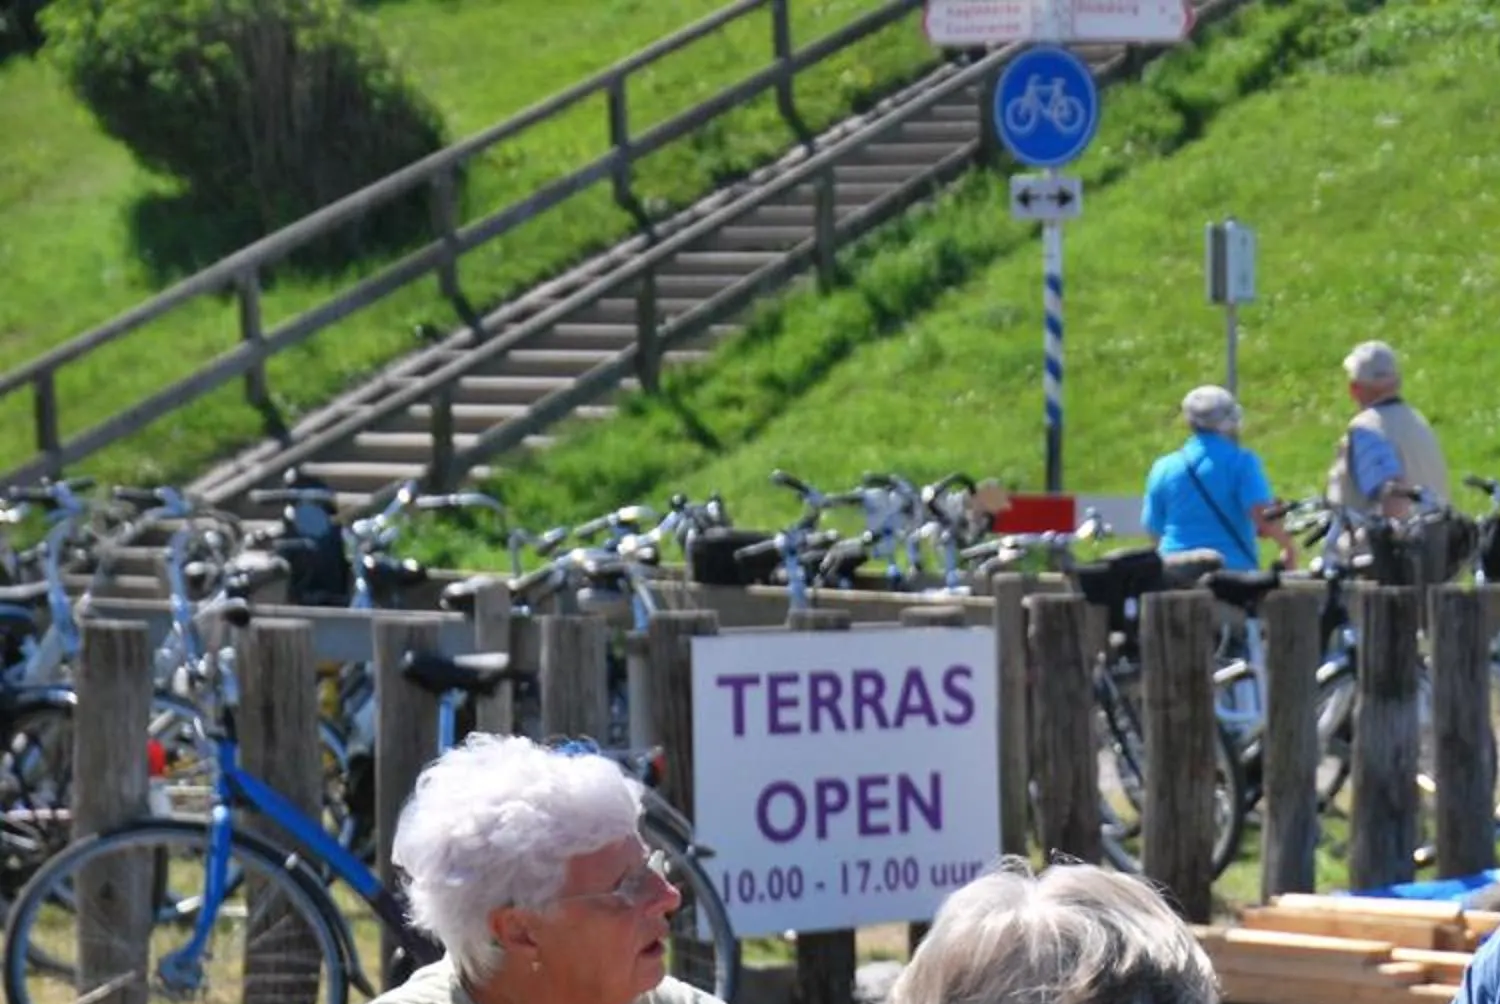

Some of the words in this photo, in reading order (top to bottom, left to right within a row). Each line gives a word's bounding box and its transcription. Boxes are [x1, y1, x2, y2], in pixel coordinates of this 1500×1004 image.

[716, 664, 975, 738] TERRAS
[756, 770, 943, 844] OPEN
[722, 864, 804, 905] 10.00
[840, 855, 920, 897] 17.00
[929, 858, 984, 889] uur
